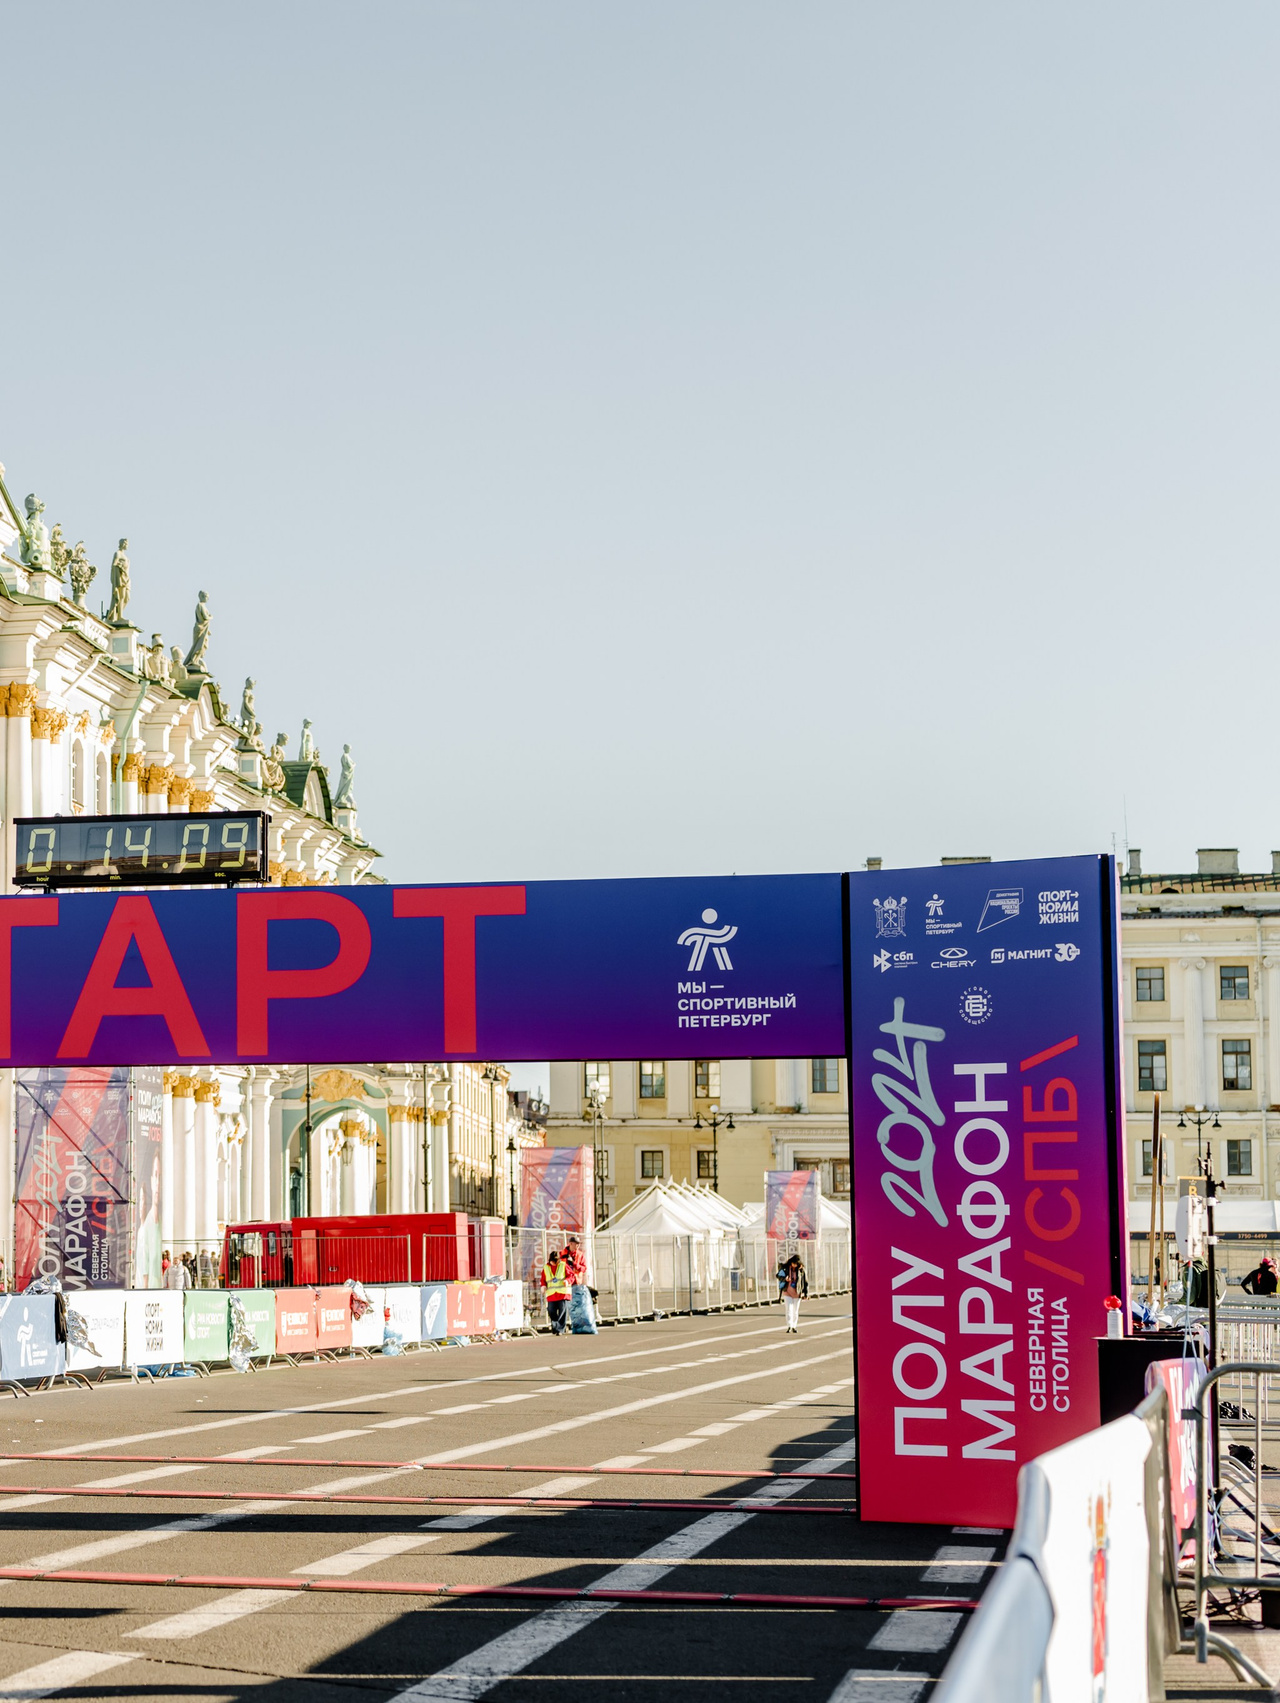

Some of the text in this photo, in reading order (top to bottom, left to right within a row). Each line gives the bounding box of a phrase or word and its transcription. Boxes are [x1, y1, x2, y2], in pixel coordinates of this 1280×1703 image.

[1038, 890, 1072, 902] СПОРТ
[1038, 901, 1079, 913] НОРМА
[925, 921, 962, 930] СПОРТИВНЫЙ
[1038, 912, 1079, 925] ЖИЗНИ
[893, 951, 914, 961] сбп
[1008, 949, 1053, 960] МАГНИТ
[931, 959, 977, 969] CHERY
[677, 981, 706, 994] МЫ
[960, 986, 992, 1001] БЕГОВОЕ
[677, 993, 797, 1011] СПОРТИВНЫЙ
[678, 1013, 771, 1028] ПЕТЕРБУРГ
[959, 1008, 993, 1026] СООБЩЕСТВО
[871, 996, 949, 1228] 2024
[91, 1233, 100, 1281] СЕВЕРНАЯ
[100, 1236, 109, 1281] СТОЛИЦА
[953, 1062, 1016, 1462] МАРАФОН
[890, 1245, 949, 1458] ПОЛУ
[1027, 1287, 1047, 1414] СЕВЕРНАЯ
[1050, 1296, 1071, 1414] СТОЛИЦА
